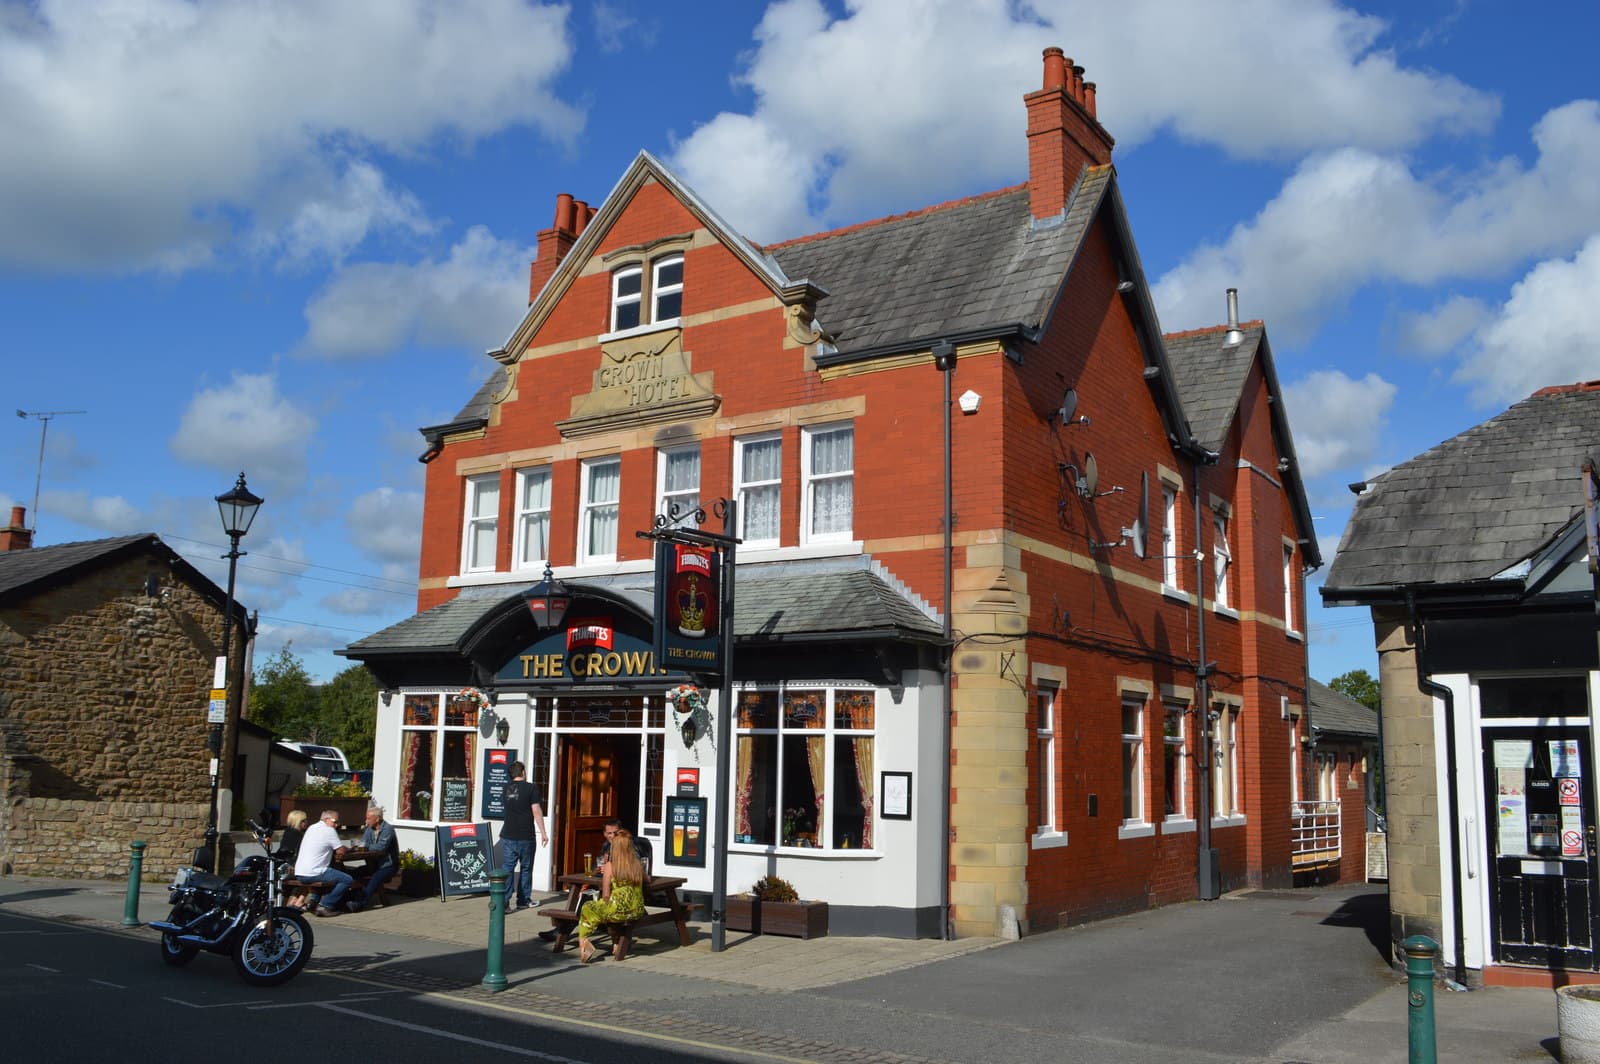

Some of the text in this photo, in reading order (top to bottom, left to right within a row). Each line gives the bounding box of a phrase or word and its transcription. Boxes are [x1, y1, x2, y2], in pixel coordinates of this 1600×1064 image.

[600, 357, 664, 388] CROWN
[629, 376, 691, 407] HOTEL
[520, 654, 563, 677] THE
[668, 648, 715, 662] THE CROWN
